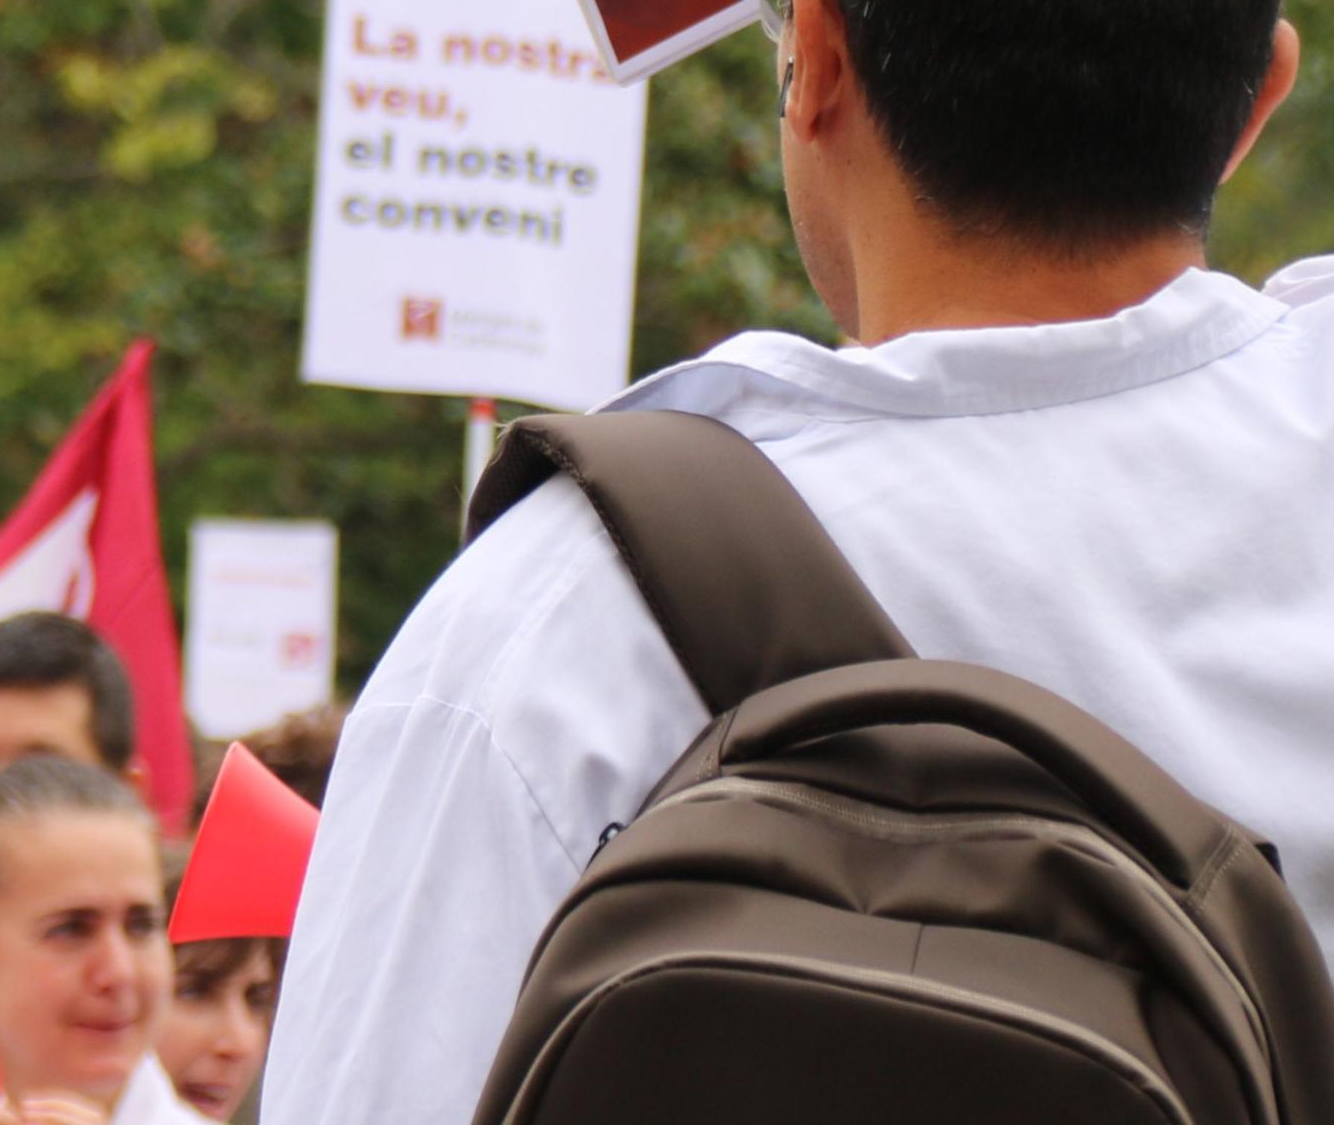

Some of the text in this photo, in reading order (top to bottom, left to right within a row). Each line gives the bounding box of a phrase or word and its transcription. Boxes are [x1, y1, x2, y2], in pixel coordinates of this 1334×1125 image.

[352, 14, 416, 57] La
[348, 77, 469, 128] veu,
[346, 130, 597, 194] el nostre
[340, 194, 563, 248] conveni
